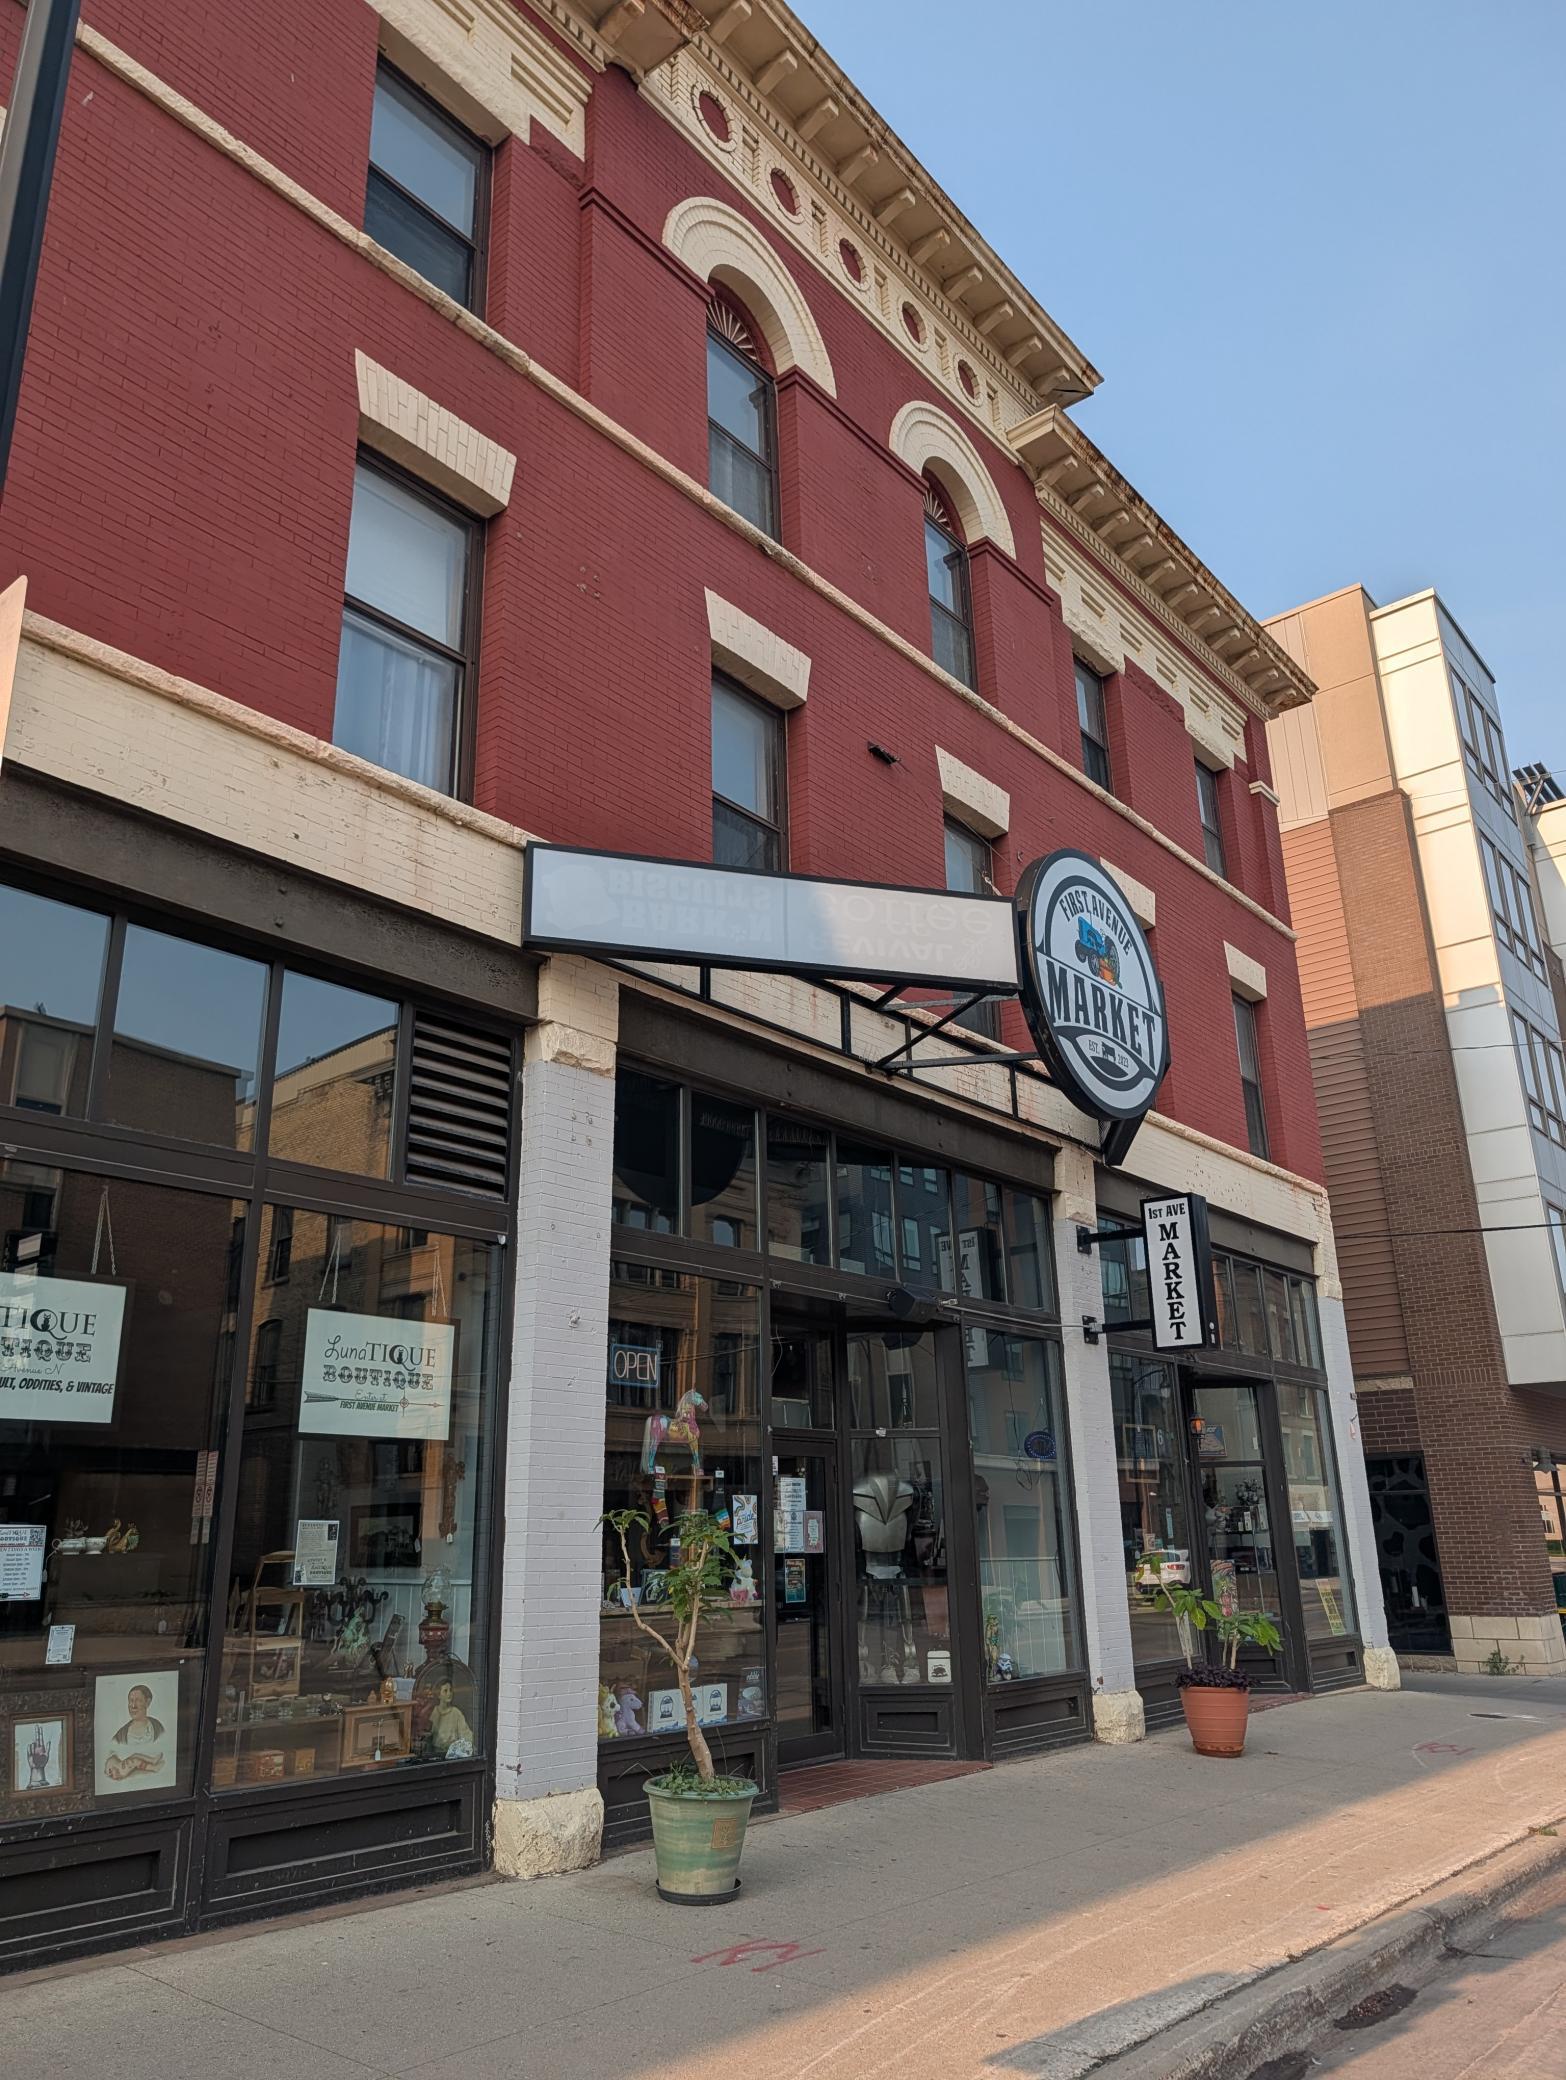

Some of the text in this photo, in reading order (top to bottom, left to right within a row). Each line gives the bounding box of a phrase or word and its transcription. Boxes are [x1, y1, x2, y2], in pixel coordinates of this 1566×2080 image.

[1059, 889, 1132, 956] FIRST AVENUE
[1045, 959, 1156, 1070] MARKET
[1147, 1202, 1186, 1220] 1ST AVE
[1158, 1221, 1188, 1341] MARKET
[323, 1364, 434, 1391] BOUTIQUE
[614, 1350, 657, 1381] OPEN
[19, 1377, 64, 1393] ODDITIES,
[66, 1380, 75, 1393] &
[76, 1381, 114, 1395] VINTAGE
[339, 1400, 400, 1412] FIRST AVENUE MARKET
